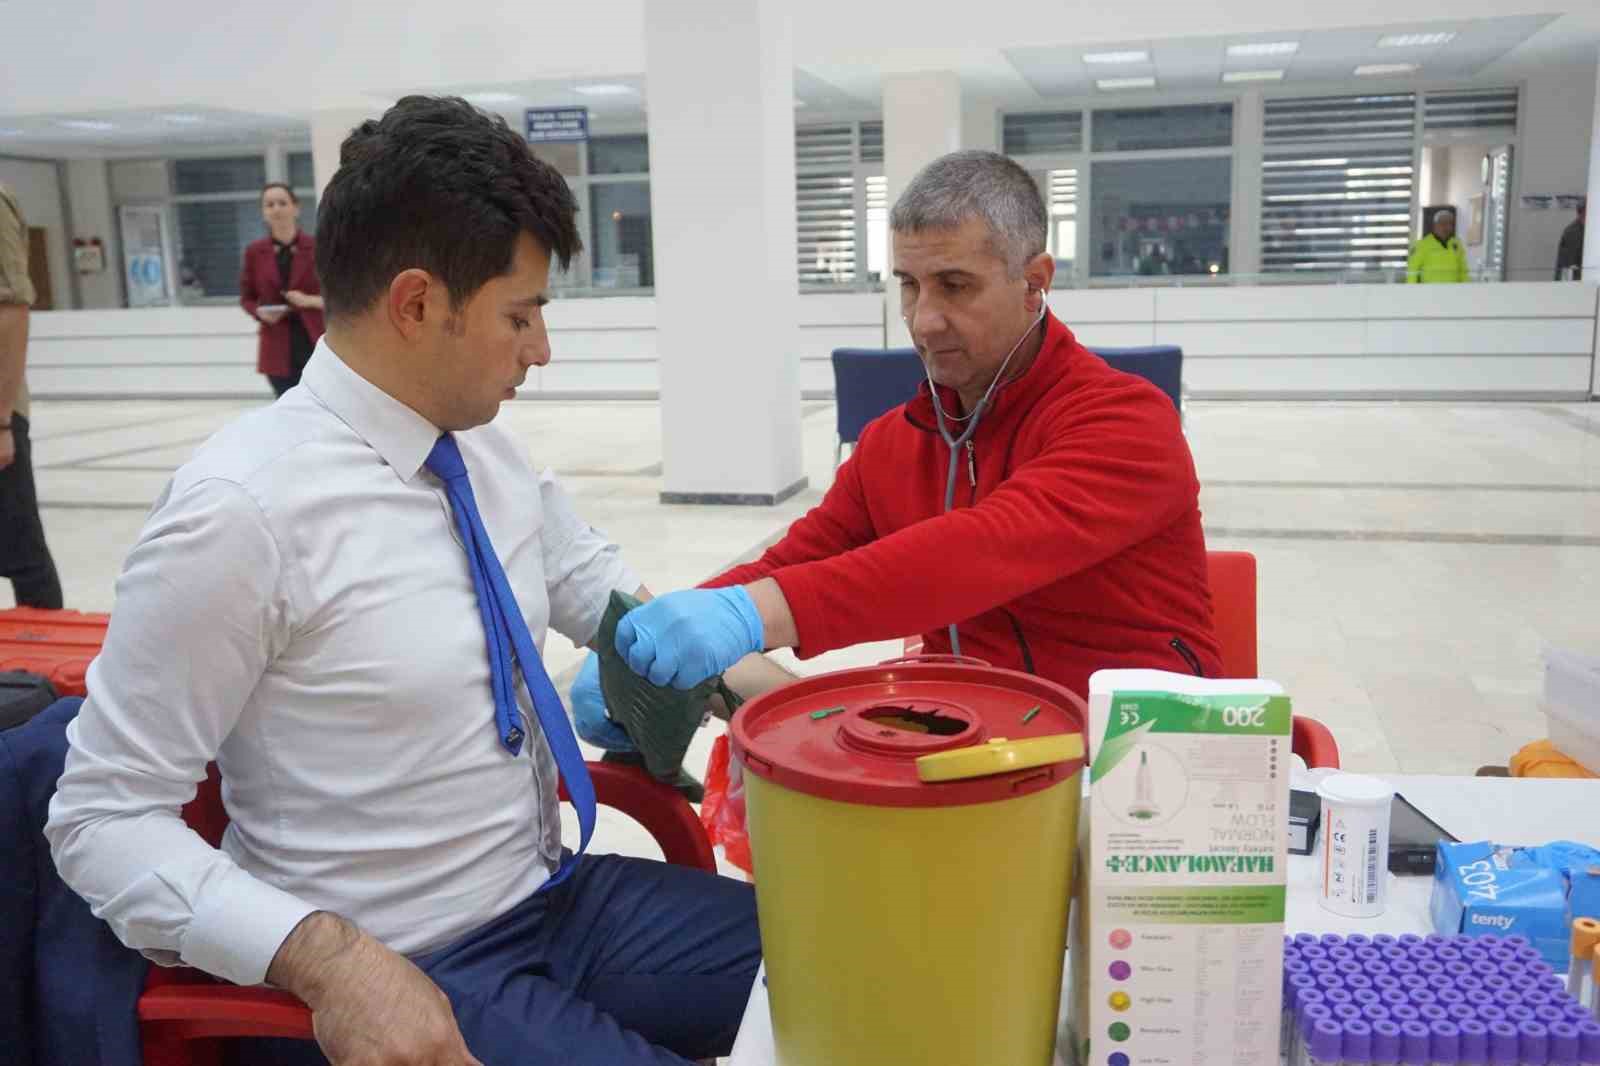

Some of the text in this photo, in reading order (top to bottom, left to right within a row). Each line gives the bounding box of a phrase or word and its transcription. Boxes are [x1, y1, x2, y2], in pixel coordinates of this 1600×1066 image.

[1223, 705, 1265, 726] 200
[1230, 813, 1275, 827] FLOW
[1210, 828, 1275, 842] NORMAL
[1458, 860, 1499, 900] 403
[1471, 912, 1514, 928] tenty
